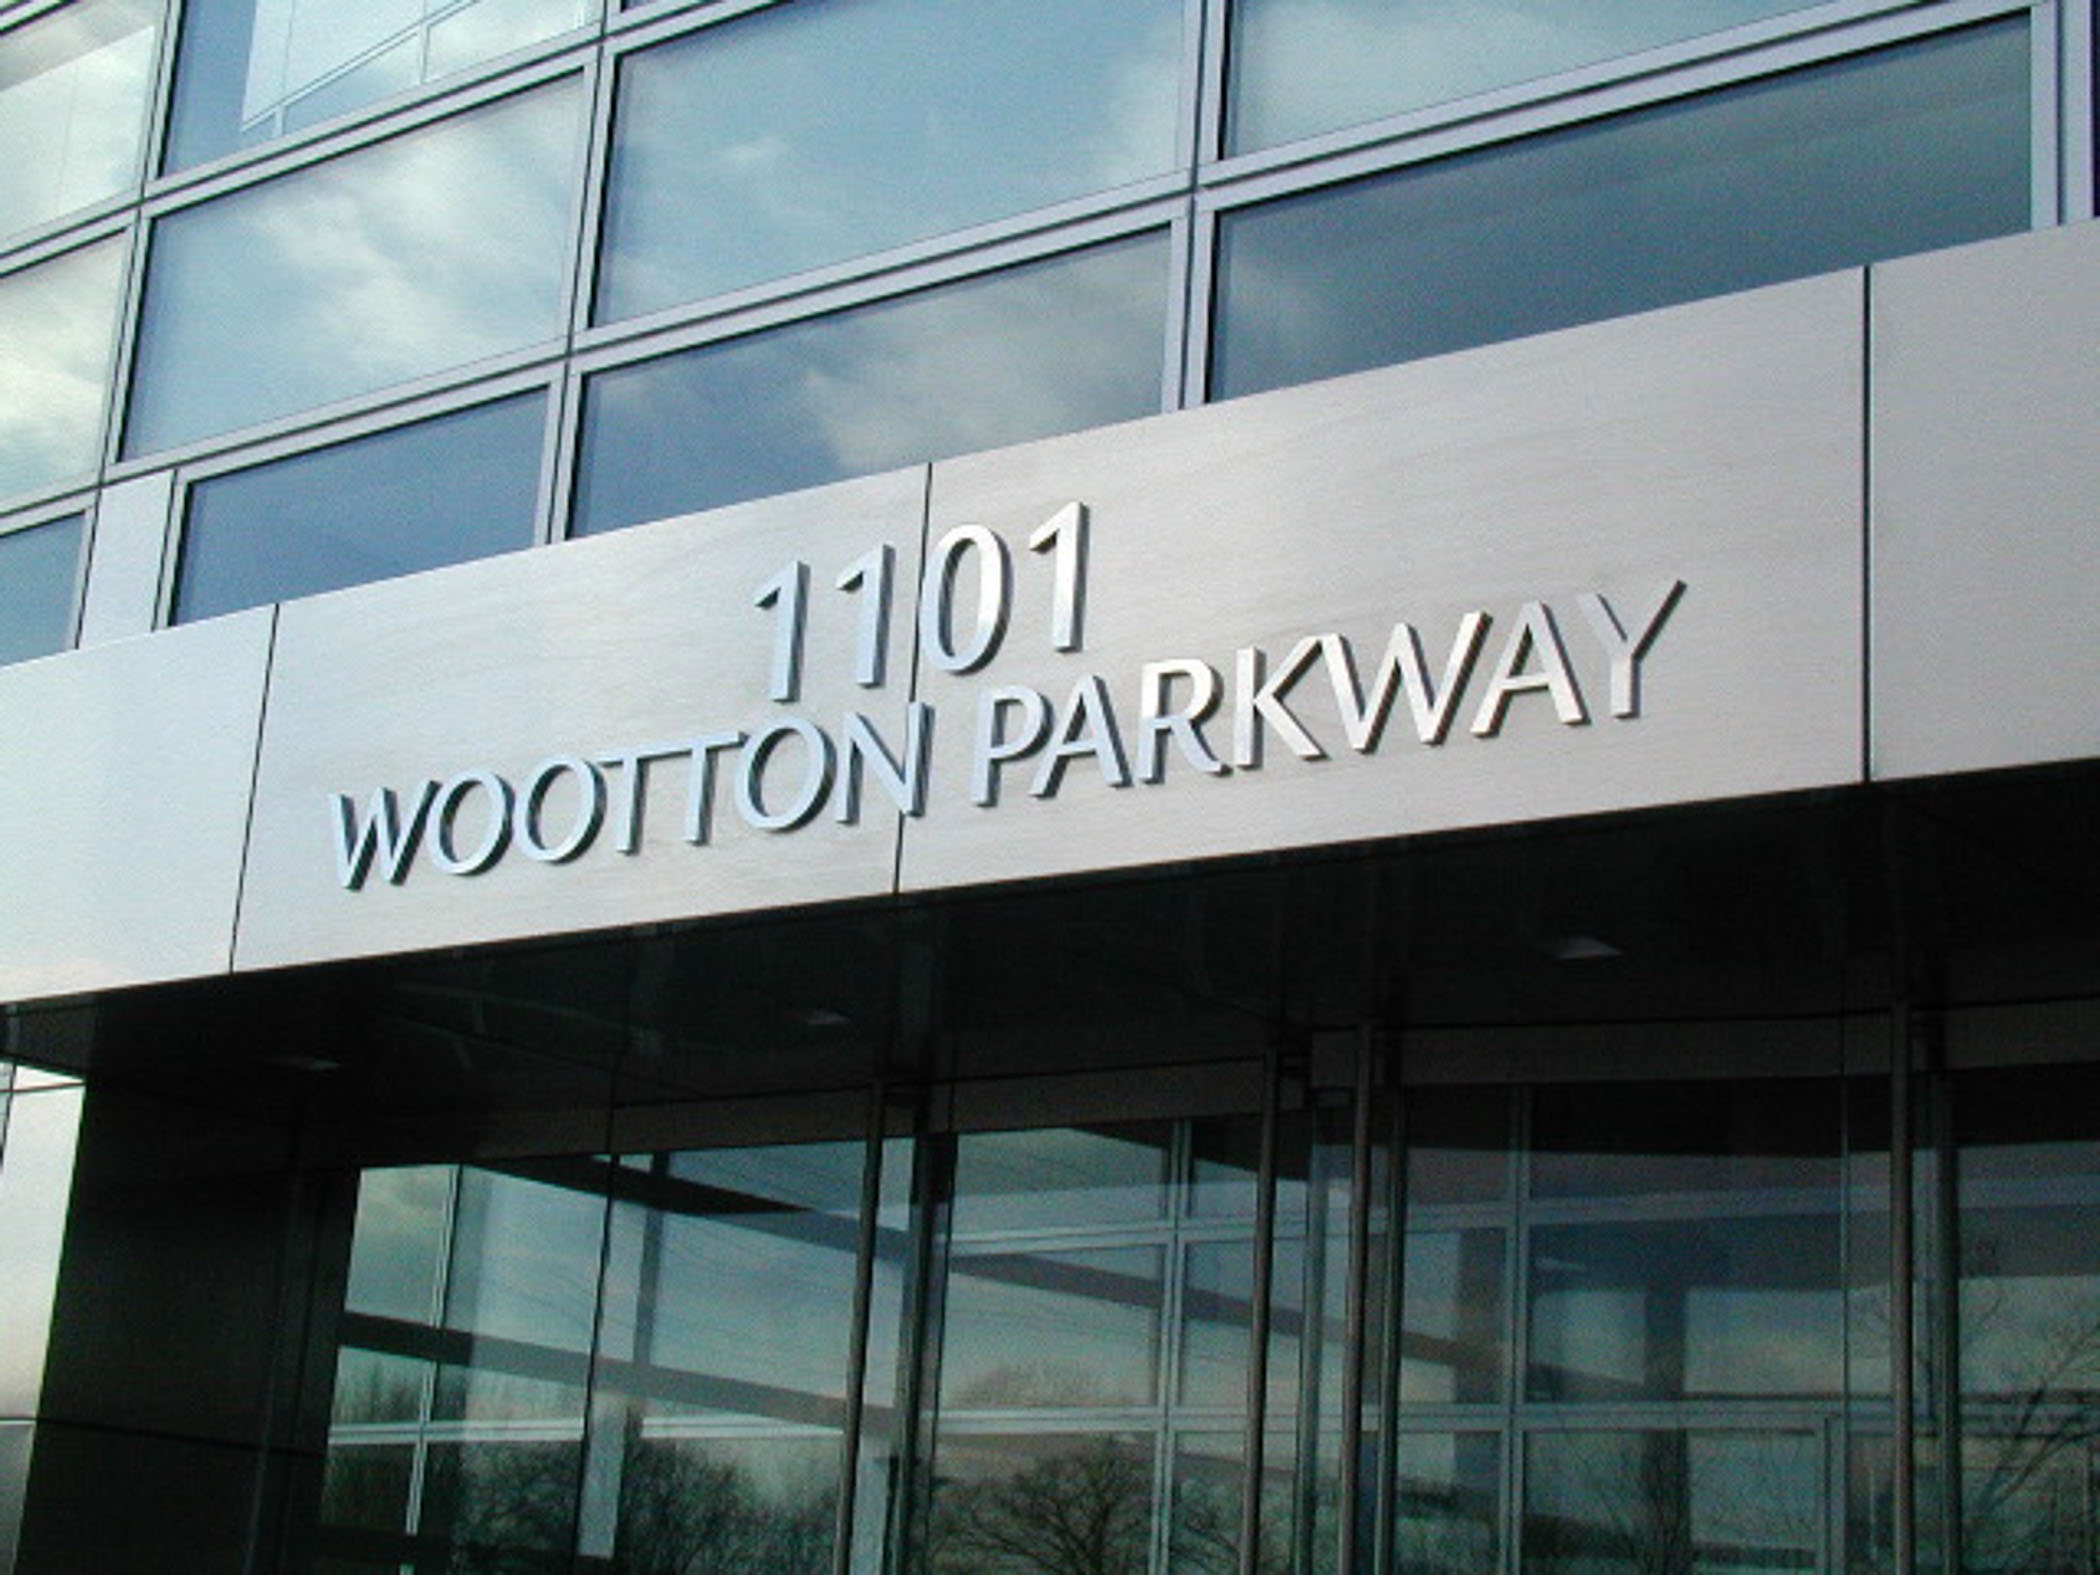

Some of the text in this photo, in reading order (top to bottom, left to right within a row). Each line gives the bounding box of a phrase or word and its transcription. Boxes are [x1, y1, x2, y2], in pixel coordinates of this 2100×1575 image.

[755, 501, 1090, 702] 1101
[330, 580, 1687, 890] WOOTTON PARKWAY
